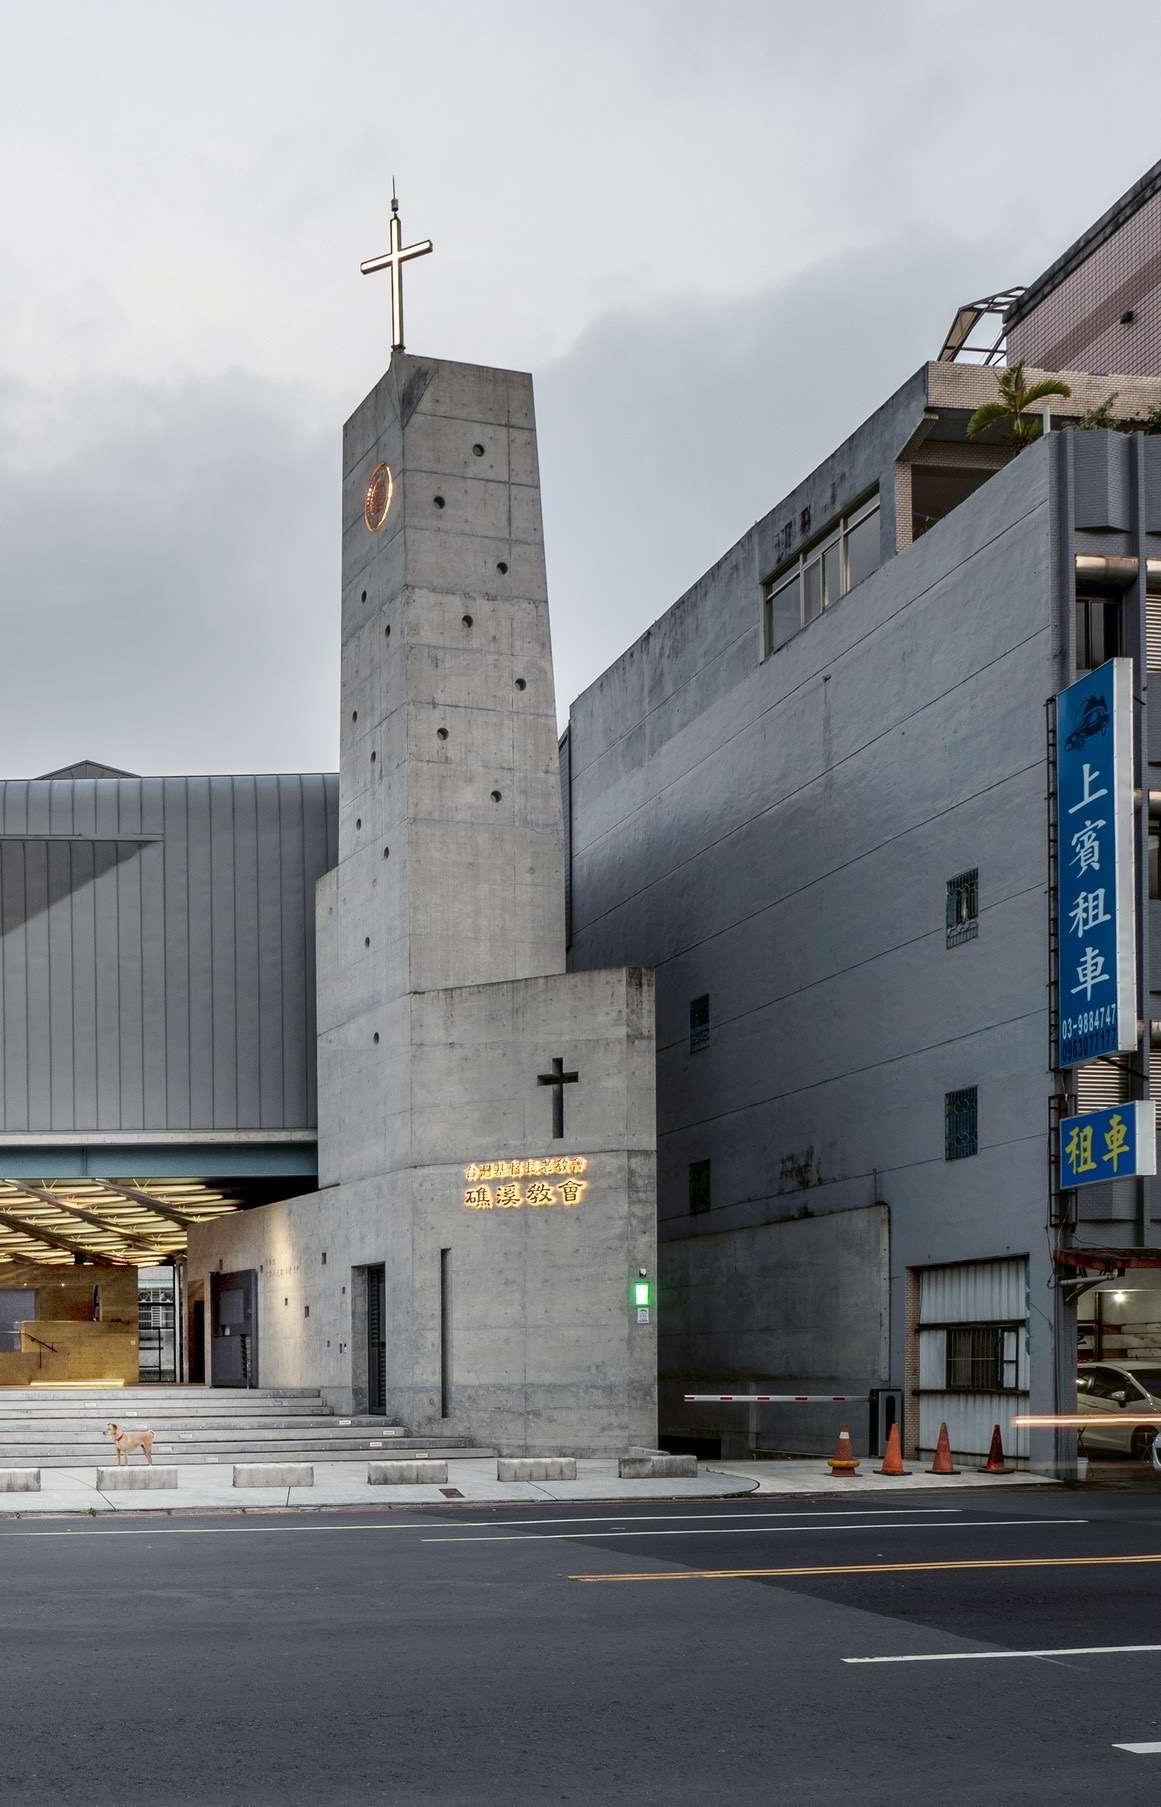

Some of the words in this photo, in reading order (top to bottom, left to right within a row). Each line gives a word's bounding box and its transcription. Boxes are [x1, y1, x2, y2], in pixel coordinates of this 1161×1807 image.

[1068, 763, 1111, 1002] 上賓租車
[1062, 1003, 1116, 1040] 03-9884747
[1065, 1113, 1130, 1175] 租車
[465, 1180, 584, 1207] 礁溪教會
